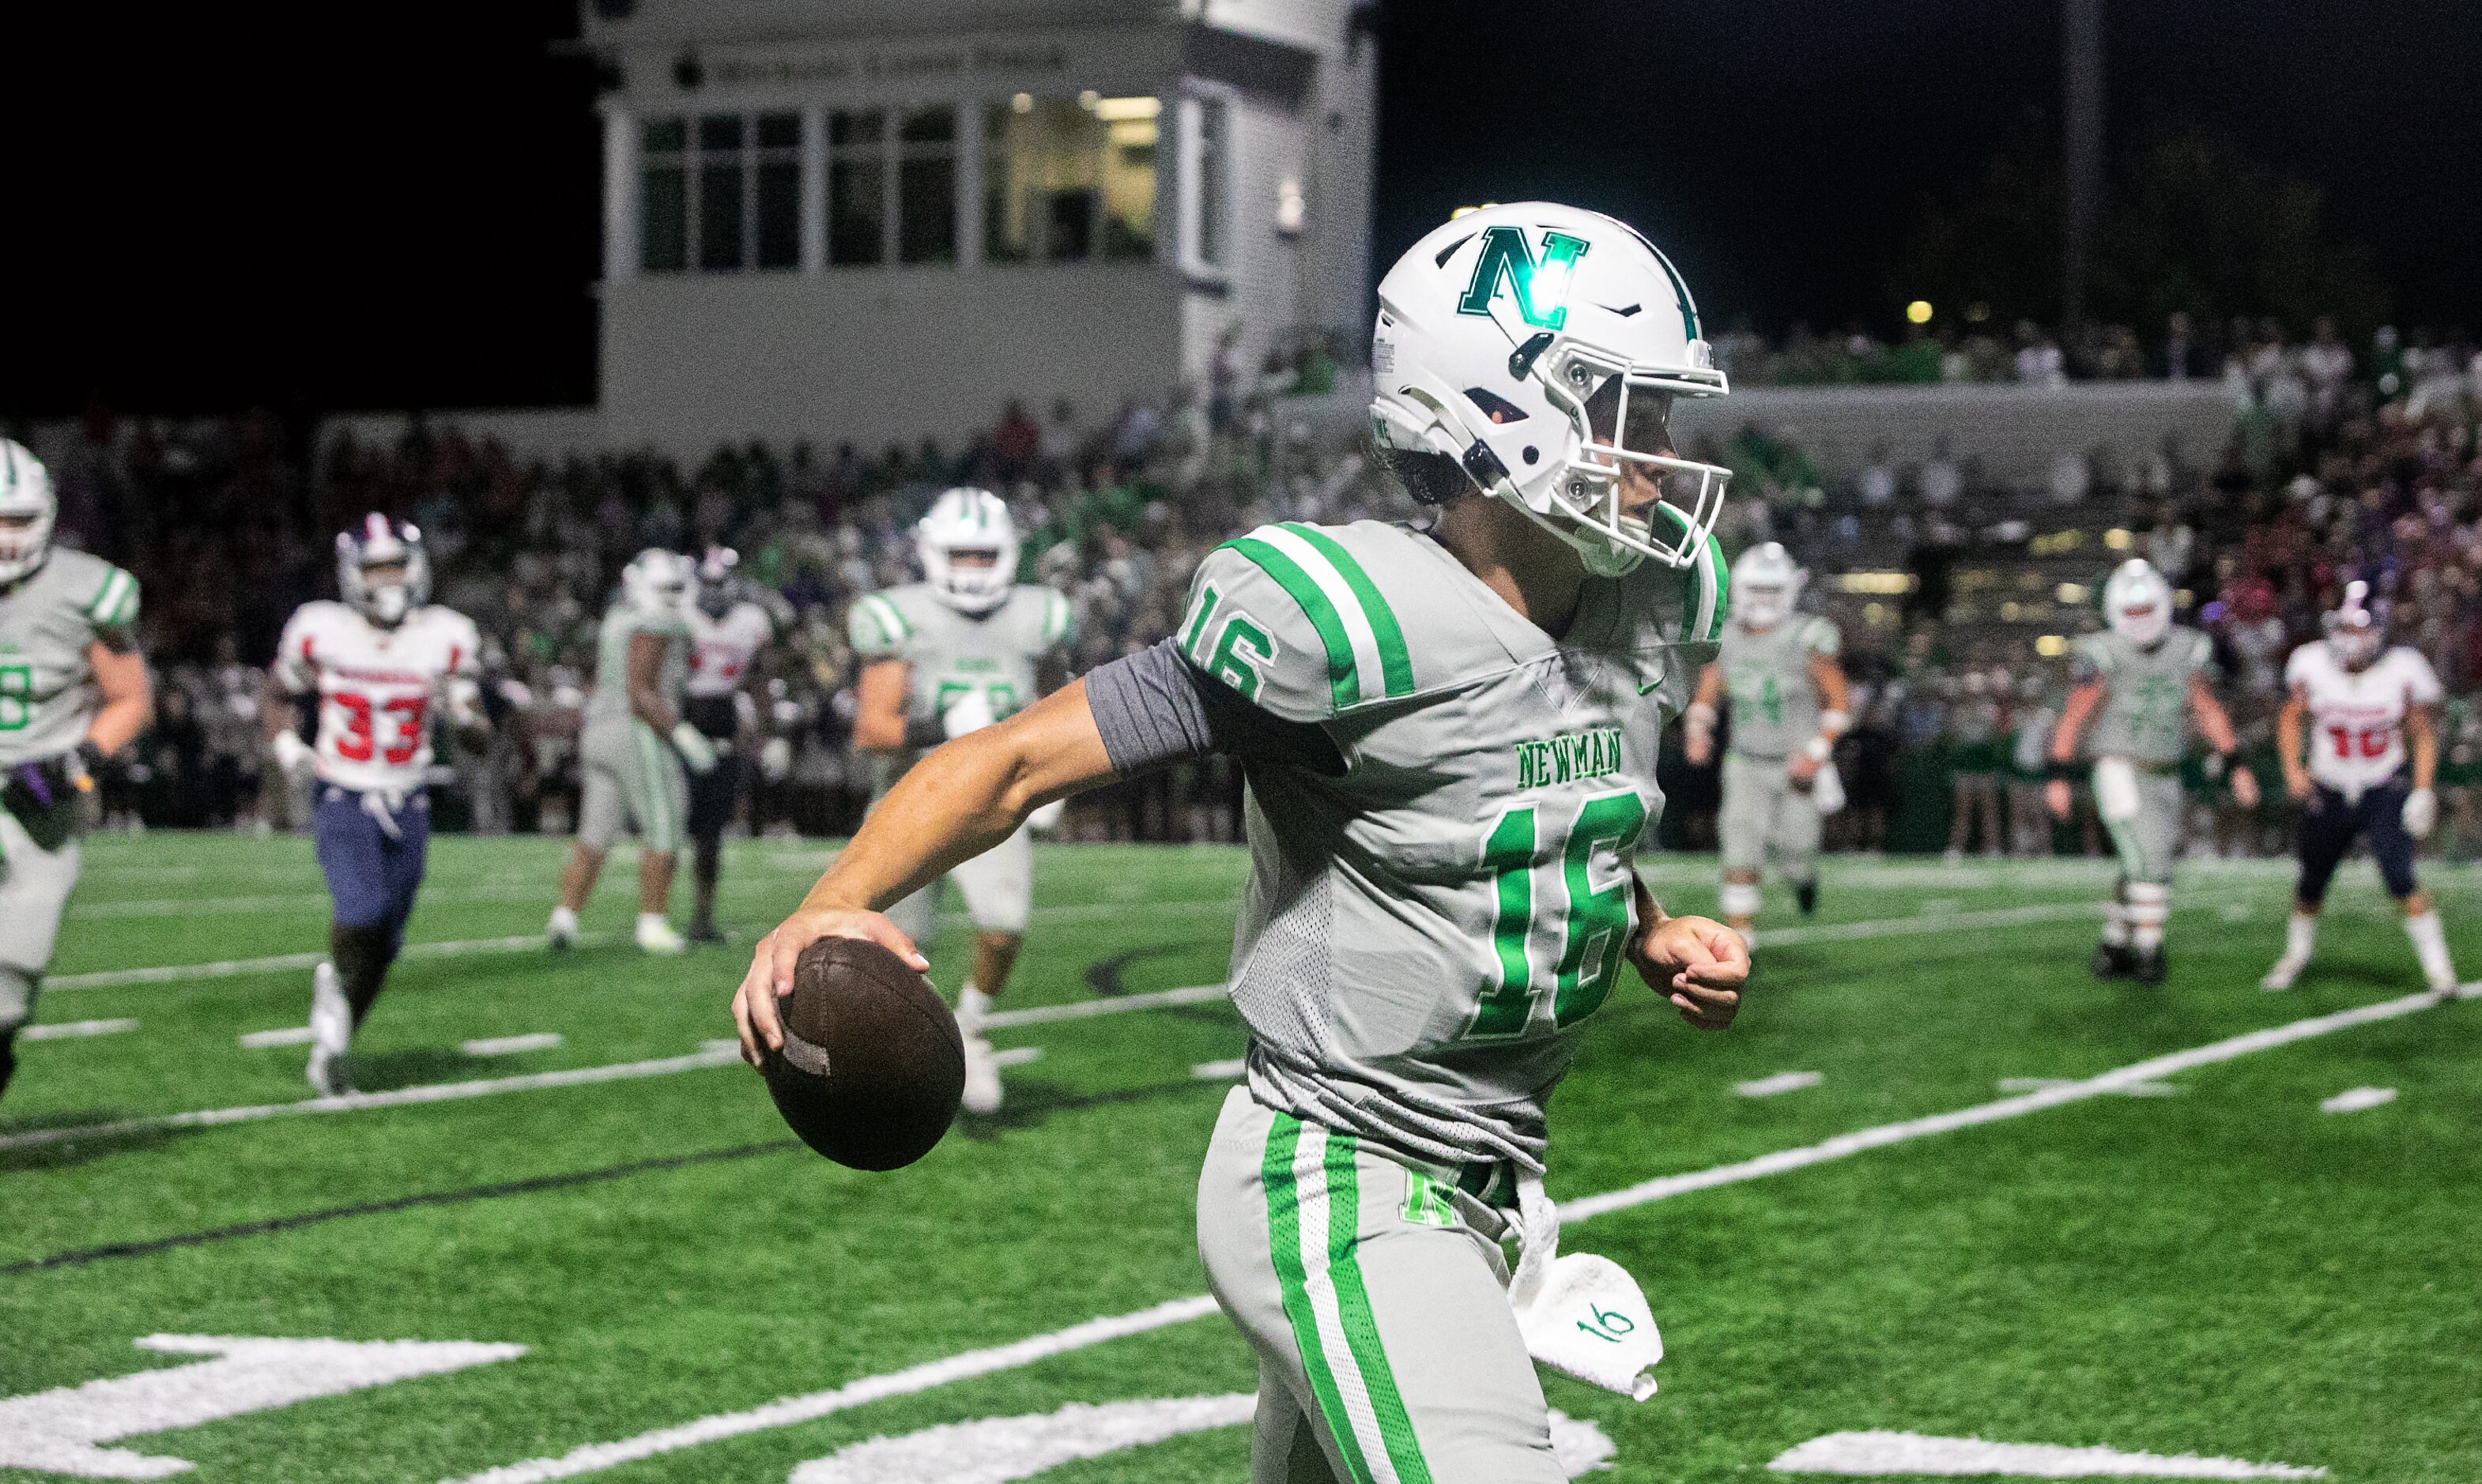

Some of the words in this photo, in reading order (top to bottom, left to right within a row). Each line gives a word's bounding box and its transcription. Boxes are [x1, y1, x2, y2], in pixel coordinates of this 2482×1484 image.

[1454, 225, 1593, 331] N
[1177, 578, 1279, 705] 16
[334, 691, 428, 765] 33
[1516, 729, 1620, 789] NEWMAN
[1462, 785, 1649, 1040] 16
[1576, 1302, 1635, 1343] 16
